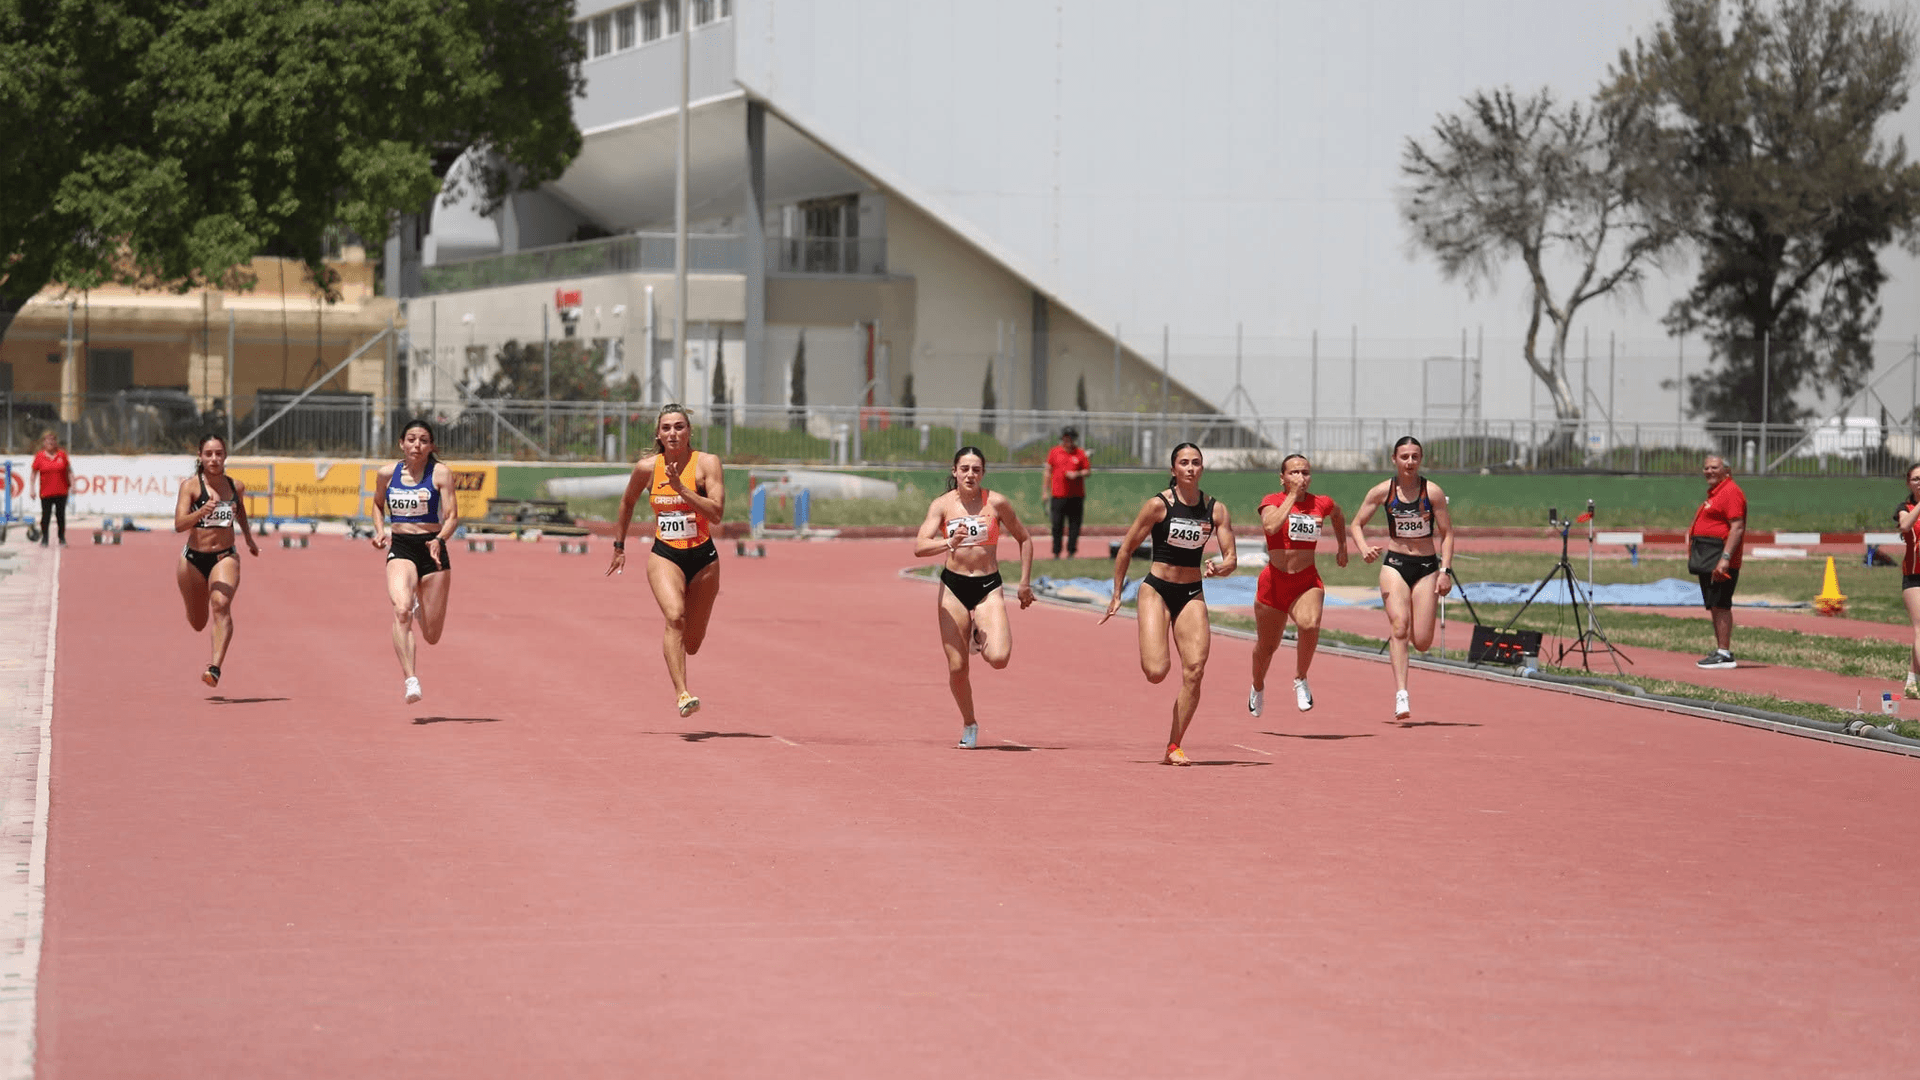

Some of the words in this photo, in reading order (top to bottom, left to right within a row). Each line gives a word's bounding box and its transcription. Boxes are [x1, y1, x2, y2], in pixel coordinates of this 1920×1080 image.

[391, 499, 418, 510] 2679
[206, 510, 232, 520] 2386
[660, 521, 685, 531] 2701
[1291, 522, 1314, 534] 2453
[1397, 521, 1423, 531] 2384
[1171, 528, 1200, 541] 2436
